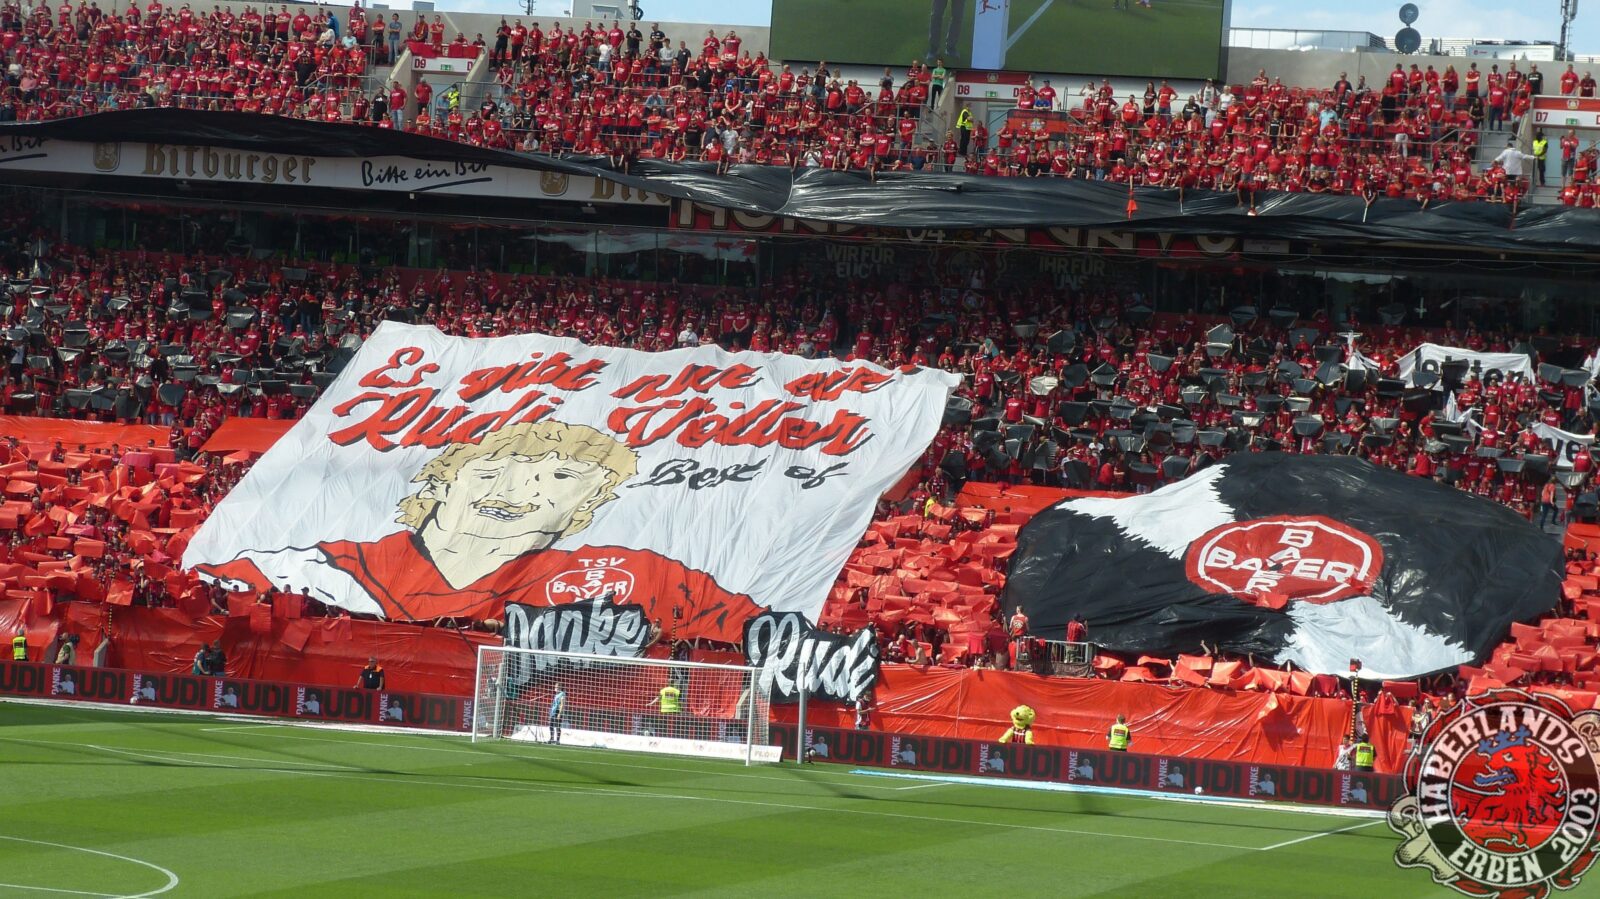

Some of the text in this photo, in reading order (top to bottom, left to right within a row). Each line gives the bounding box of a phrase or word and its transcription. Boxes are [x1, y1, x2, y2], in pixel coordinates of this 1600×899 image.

[957, 85, 970, 95] D8
[1535, 111, 1549, 122] D7
[142, 142, 317, 184] Bitburger
[361, 160, 408, 187] Bitte
[414, 162, 450, 181] ein
[825, 245, 860, 262] WIR
[358, 346, 440, 388] Es
[457, 351, 611, 403] gibt
[609, 363, 764, 402] nur
[328, 387, 875, 456] Rudi Völler
[626, 455, 850, 490] Best of
[577, 556, 627, 568] TSV
[1205, 546, 1355, 584] BAYER
[504, 591, 648, 685] Danke
[747, 612, 875, 701] Rudi
[0, 664, 45, 693] UDI
[51, 667, 61, 695] DANKE
[133, 673, 142, 699] ANKE
[214, 680, 223, 708] DANKE
[296, 687, 305, 715] DANKE
[379, 693, 388, 722] DANKE
[891, 736, 900, 765] DANKE
[979, 744, 989, 773] DANKE
[1068, 751, 1078, 780] DANKE
[1158, 759, 1168, 788] DANKE
[1249, 766, 1259, 796] DANKE
[1341, 774, 1351, 803] DANKE
